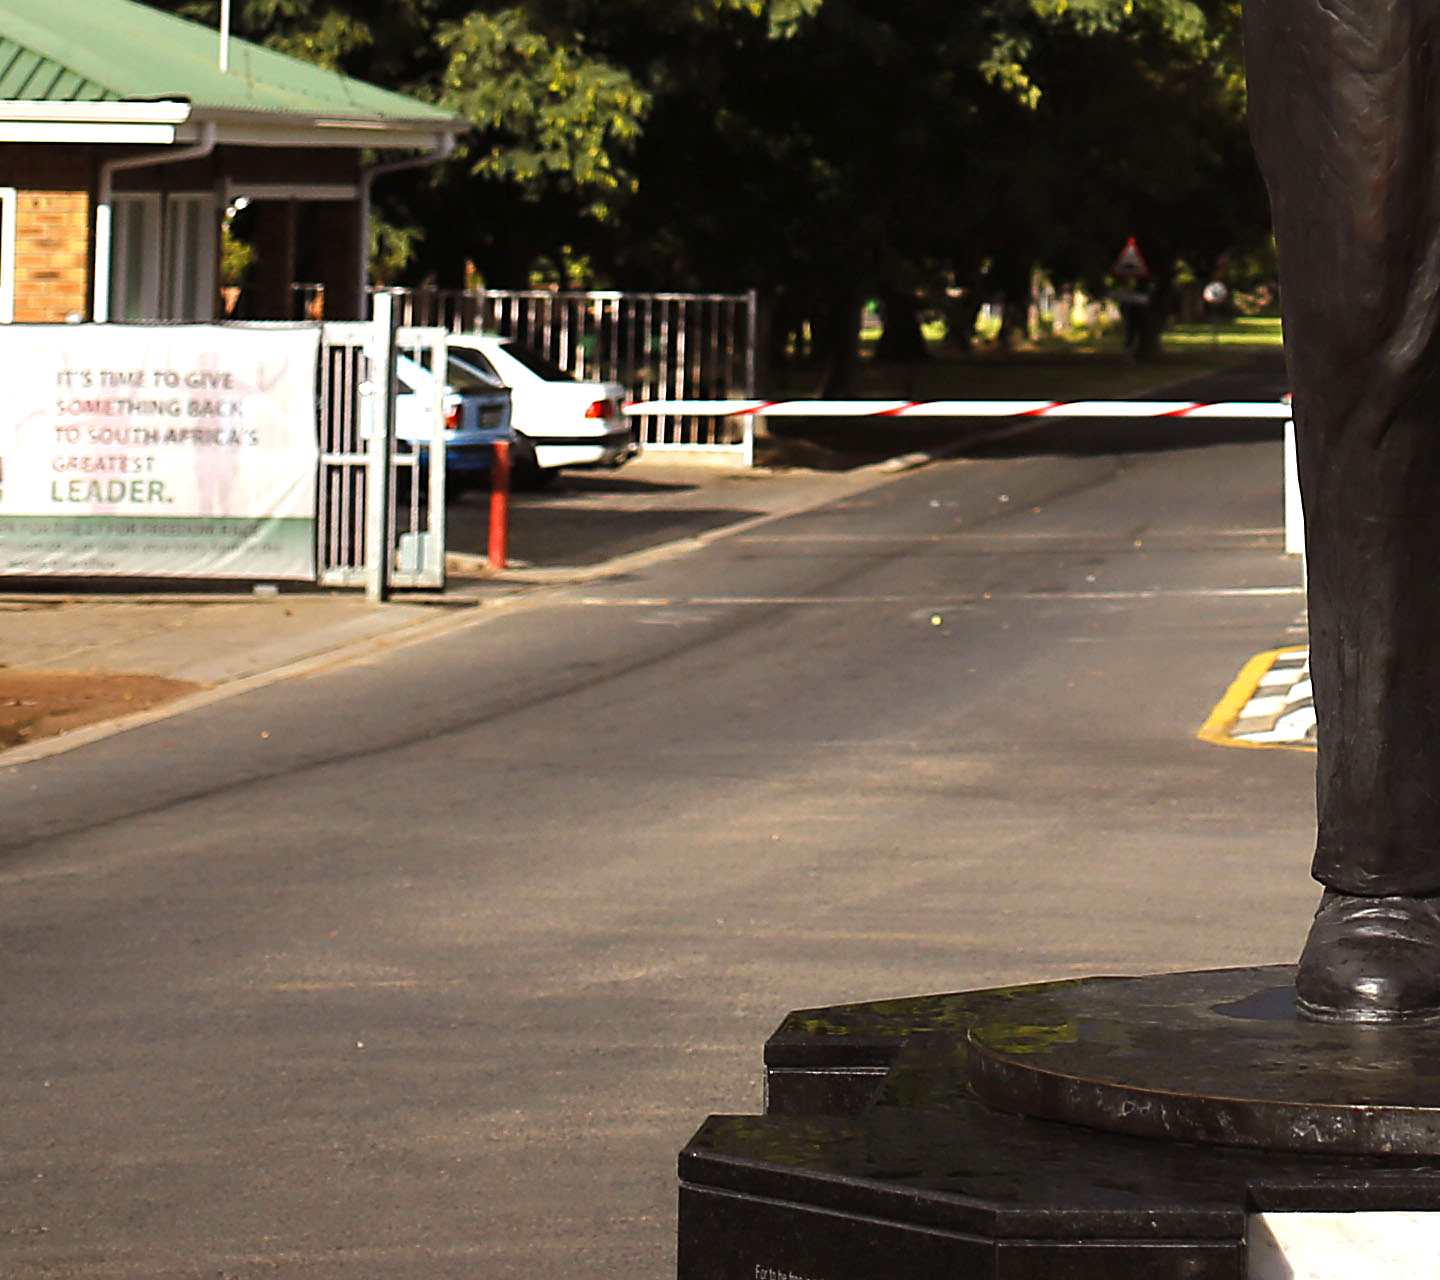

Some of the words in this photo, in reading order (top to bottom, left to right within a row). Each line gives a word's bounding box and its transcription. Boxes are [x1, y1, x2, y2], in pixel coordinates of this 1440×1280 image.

[56, 370, 92, 388] IT'S
[100, 370, 145, 388] TIME
[154, 371, 180, 389] TO
[184, 371, 234, 390] GIVE
[56, 398, 182, 417] SOMETHING
[187, 400, 243, 418] BACK
[55, 427, 80, 444] TO
[88, 428, 159, 445] SOUTH
[164, 428, 259, 446] AFRICA'S
[52, 455, 155, 473] GREATEST
[51, 479, 174, 503] LEADER.
